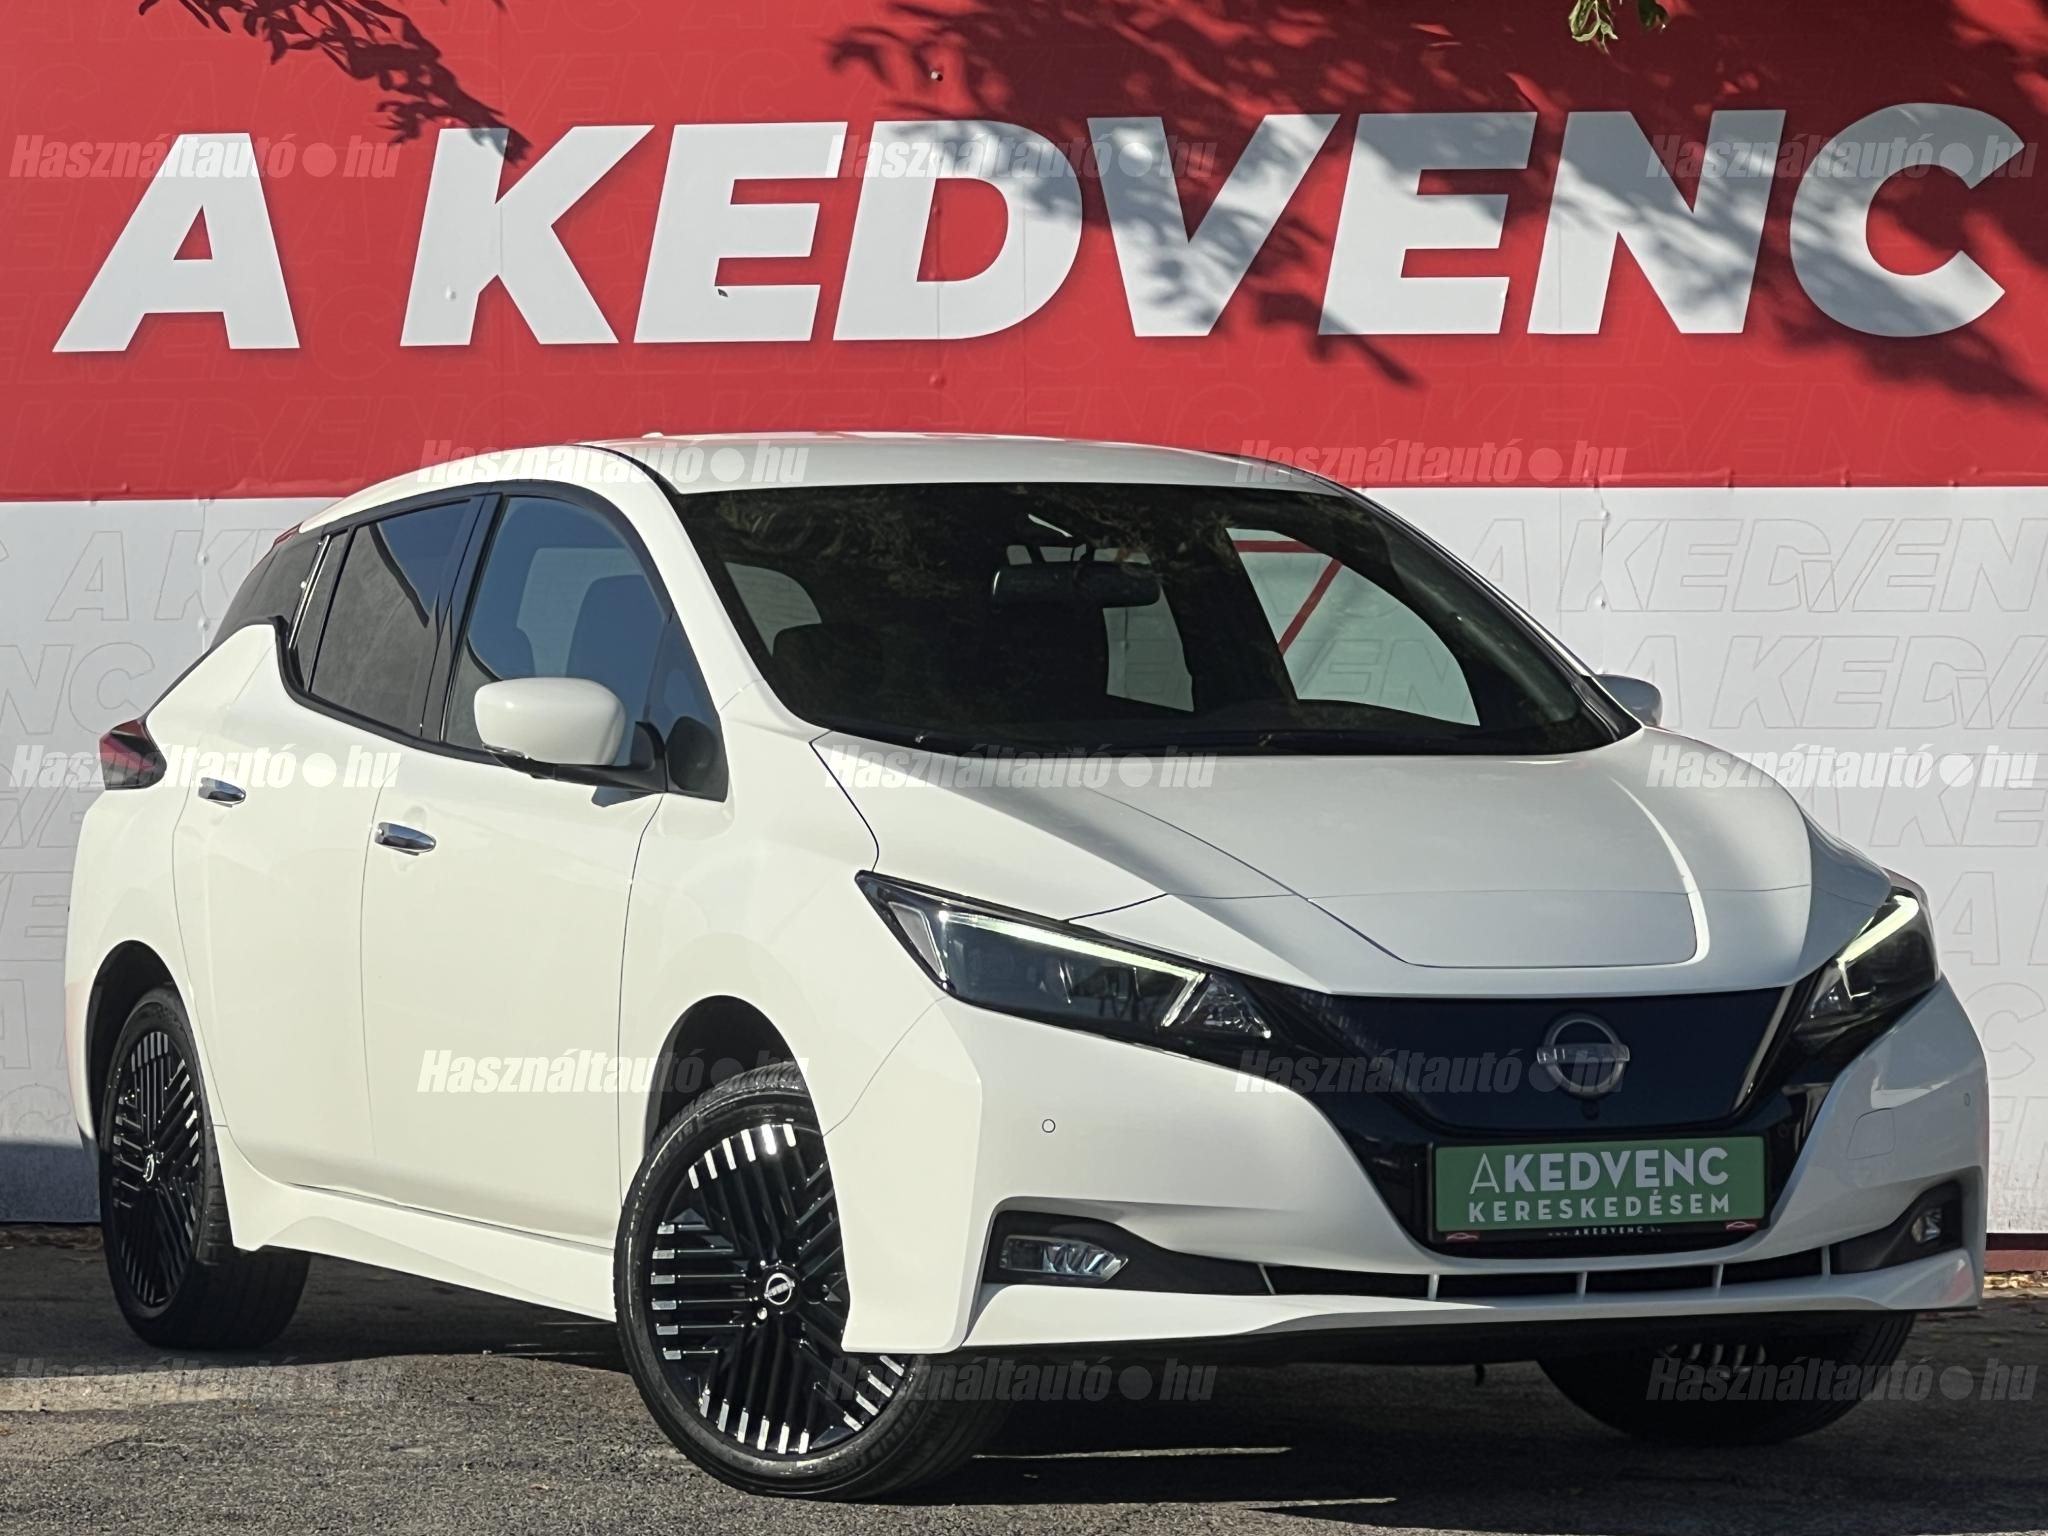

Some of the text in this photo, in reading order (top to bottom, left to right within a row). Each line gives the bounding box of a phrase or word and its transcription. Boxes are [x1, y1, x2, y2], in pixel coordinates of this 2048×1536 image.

[53, 133, 300, 353] A
[400, 102, 2025, 348] KEDVENC
[1469, 1189, 1730, 1223] KERESKEDÉSEM
